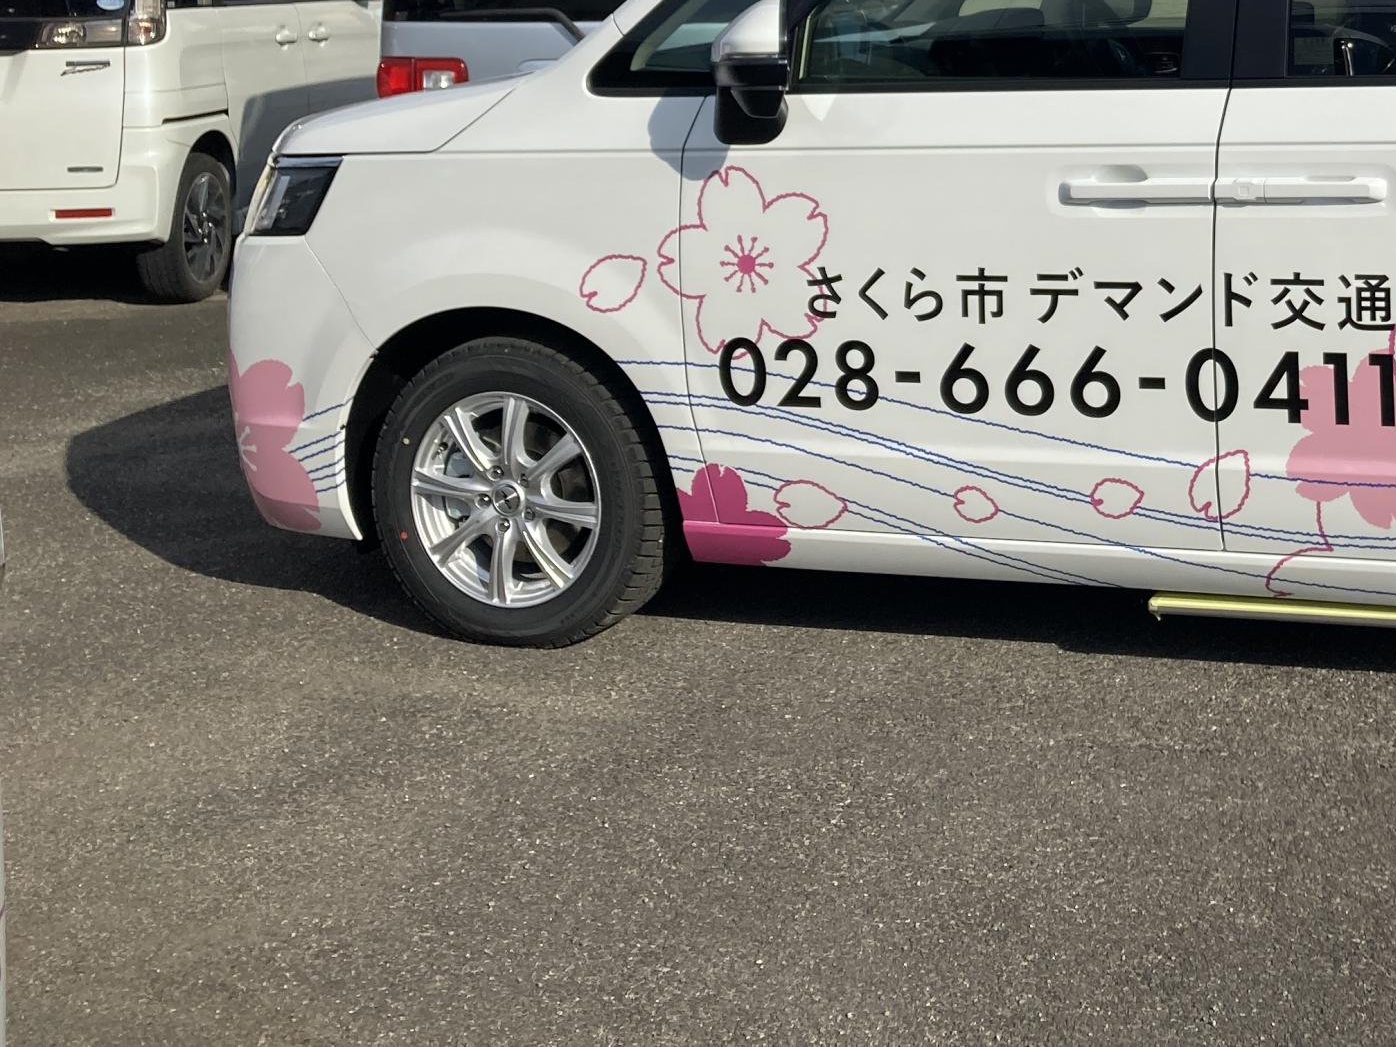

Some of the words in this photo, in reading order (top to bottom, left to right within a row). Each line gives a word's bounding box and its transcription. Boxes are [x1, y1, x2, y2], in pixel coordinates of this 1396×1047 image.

[807, 265, 1008, 325] さくら市
[1030, 267, 1396, 331] デマンド交通
[718, 337, 1396, 428] 028-666-0411
